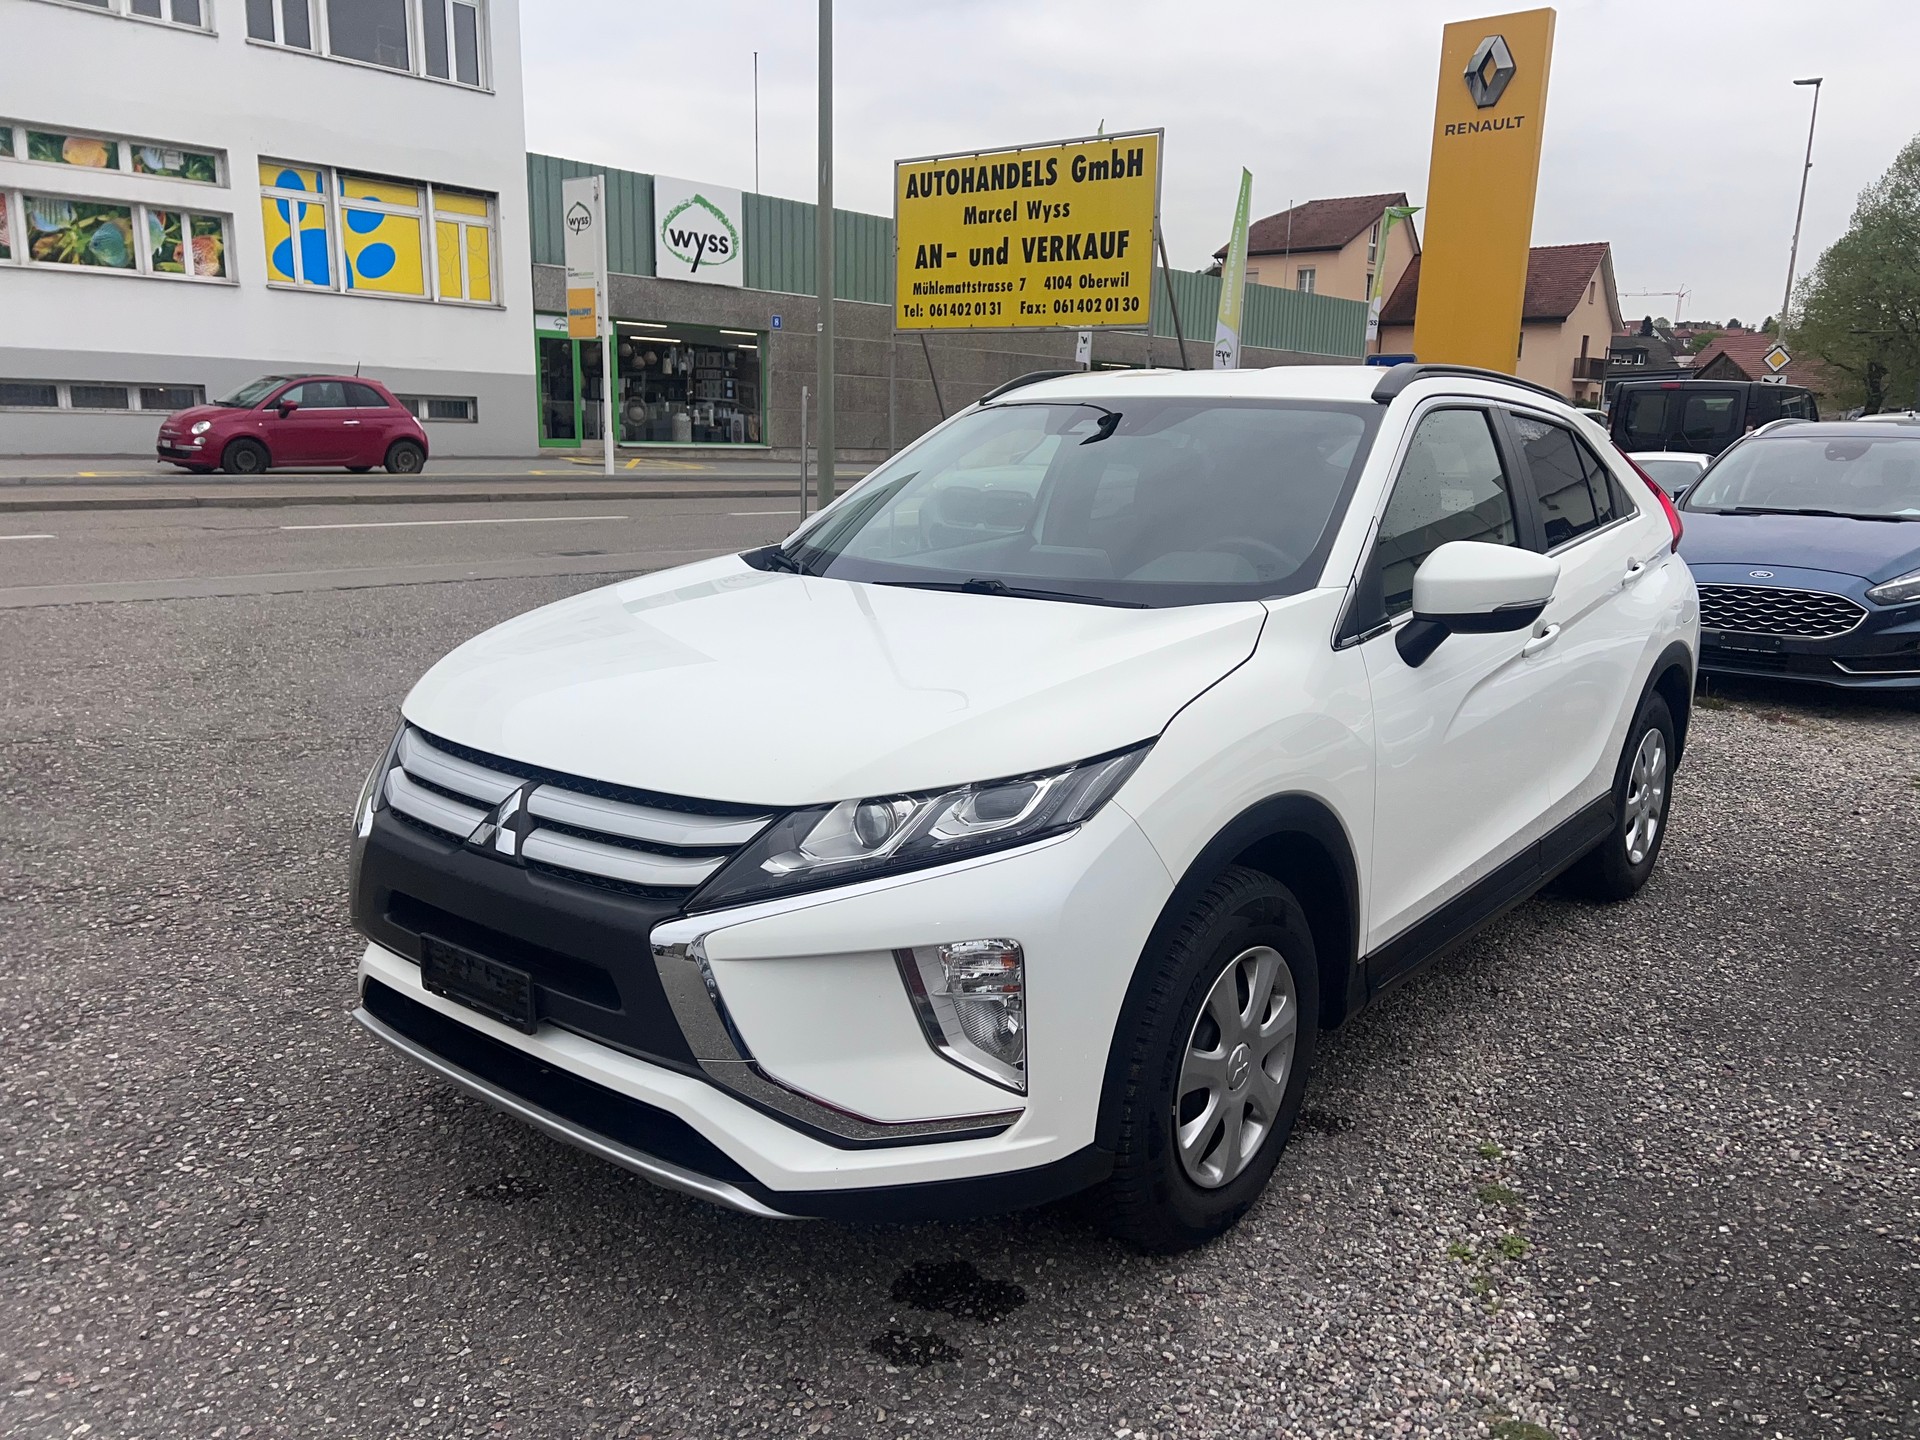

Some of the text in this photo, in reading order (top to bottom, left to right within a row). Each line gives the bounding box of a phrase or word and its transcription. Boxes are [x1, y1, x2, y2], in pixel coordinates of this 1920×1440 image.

[1445, 115, 1525, 136] RENAULT
[906, 148, 1144, 199] AUTOHANDELS GmbH
[963, 200, 1071, 225] Marcel Wyss
[569, 216, 588, 235] wyss
[669, 228, 729, 273] wyss
[969, 236, 1008, 267] und
[1021, 230, 1130, 264] VERKAUF
[912, 271, 1130, 296] Mühlemattstrasse 7 4104 Oberwil
[904, 303, 923, 317] Tel:
[1020, 300, 1046, 314] Fax:
[774, 317, 780, 327] 8
